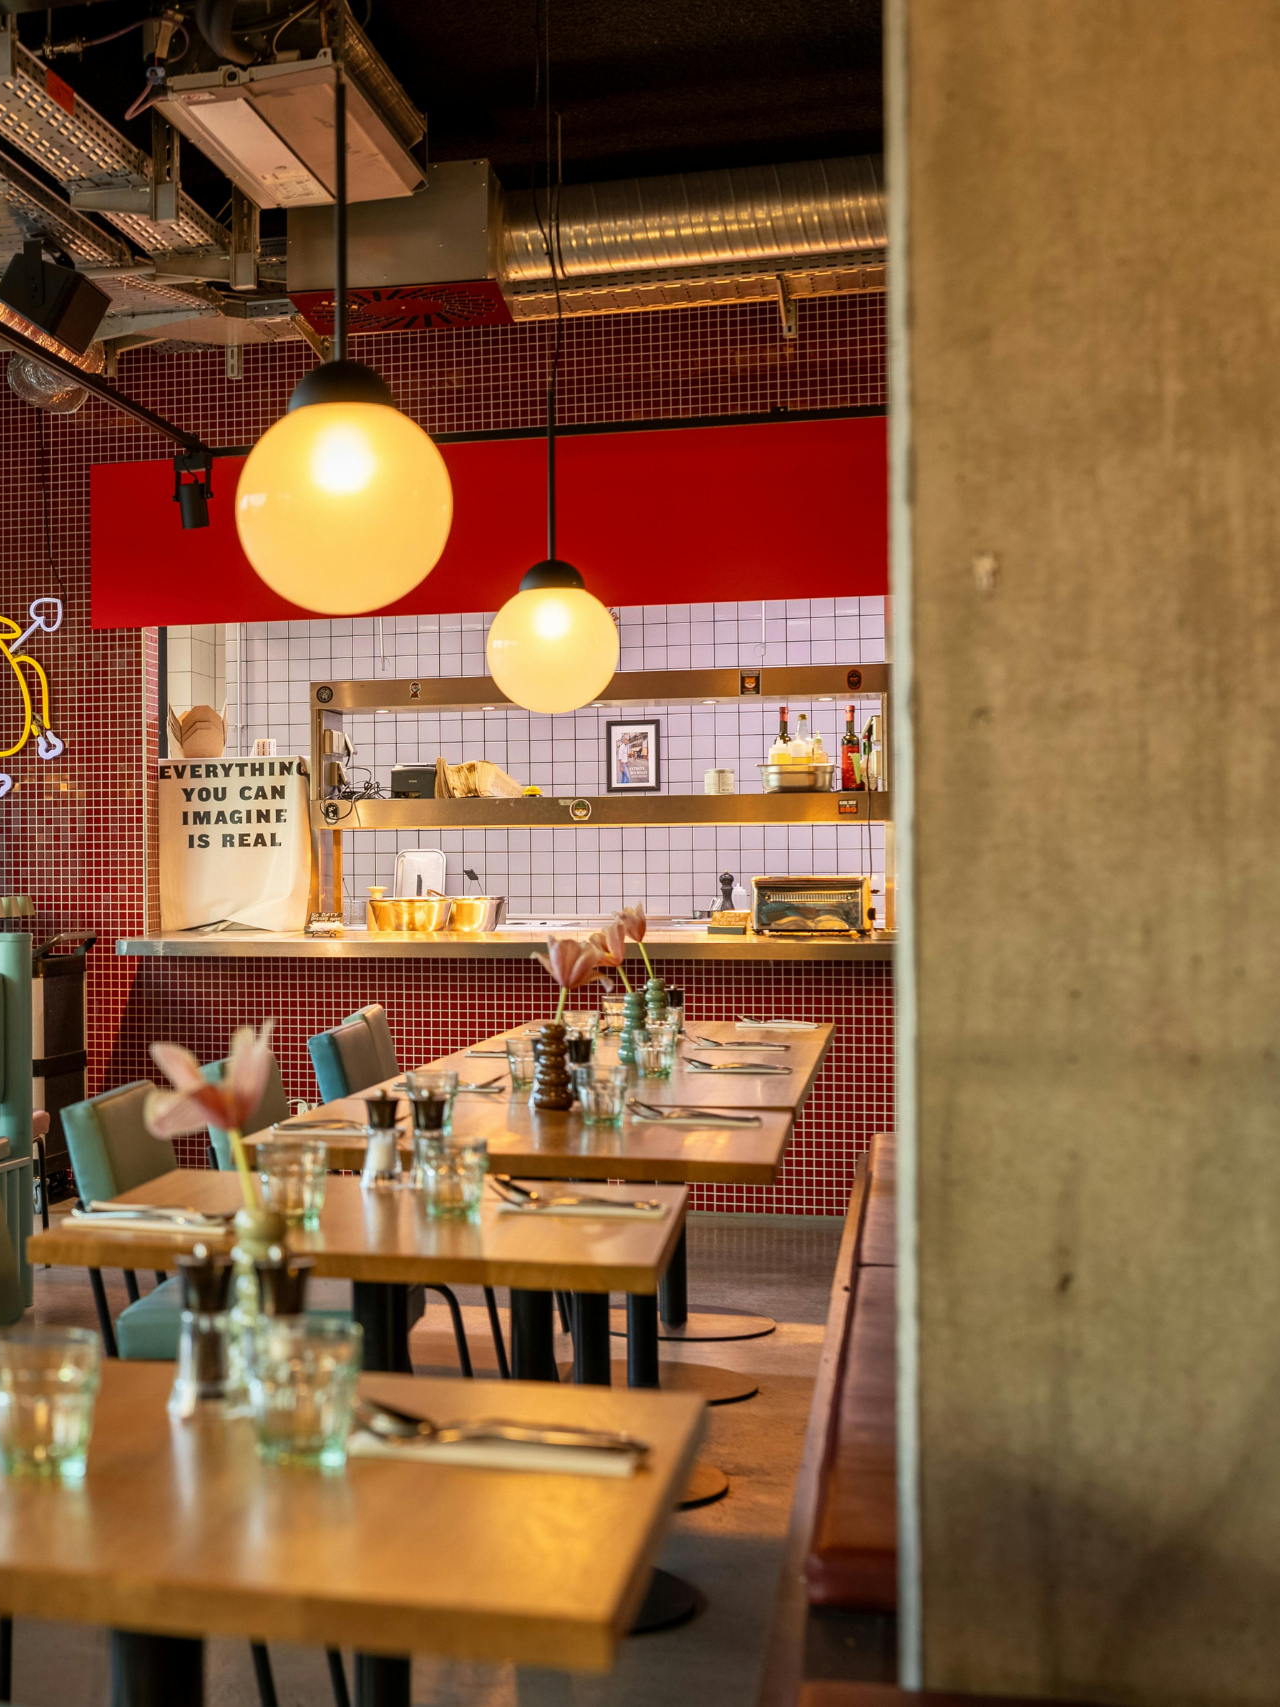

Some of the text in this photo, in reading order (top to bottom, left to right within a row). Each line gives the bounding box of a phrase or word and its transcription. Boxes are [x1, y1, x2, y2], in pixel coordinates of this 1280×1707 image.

[182, 785, 286, 802] YOU CAN
[182, 808, 287, 826] IMAGINE
[188, 832, 282, 849] IS REAL
